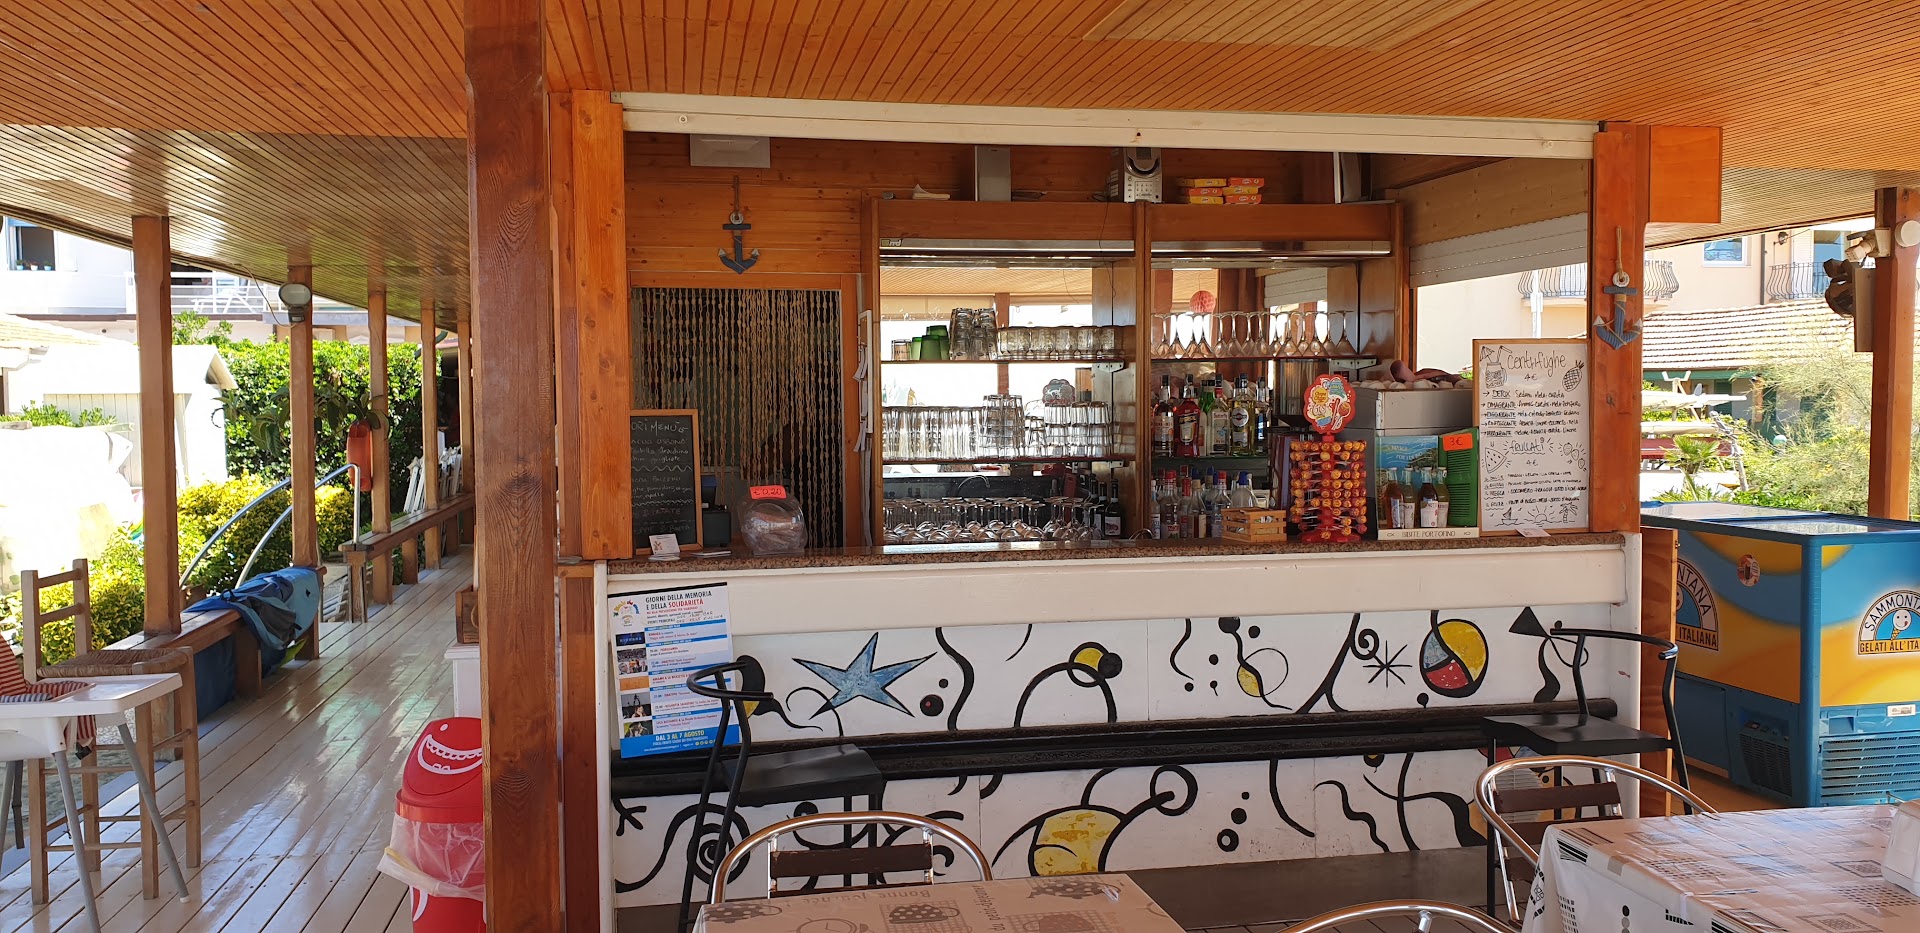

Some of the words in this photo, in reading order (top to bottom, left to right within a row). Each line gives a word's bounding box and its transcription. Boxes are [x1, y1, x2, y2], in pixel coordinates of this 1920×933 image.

[1507, 350, 1567, 378] Centrifughe
[1492, 389, 1511, 398] DETOX
[1421, 530, 1456, 538] PORTOFINO
[645, 596, 666, 604] GIORNI
[667, 593, 684, 601] DELLA
[684, 590, 712, 599] MEMORIA
[650, 602, 668, 610] DELLA
[1864, 593, 1920, 632] SAMMONT
[1679, 626, 1717, 648] ITALIANA
[1859, 642, 1887, 653] GELATI
[684, 730, 705, 738] AGOSTO
[879, 889, 932, 899] Bonne
